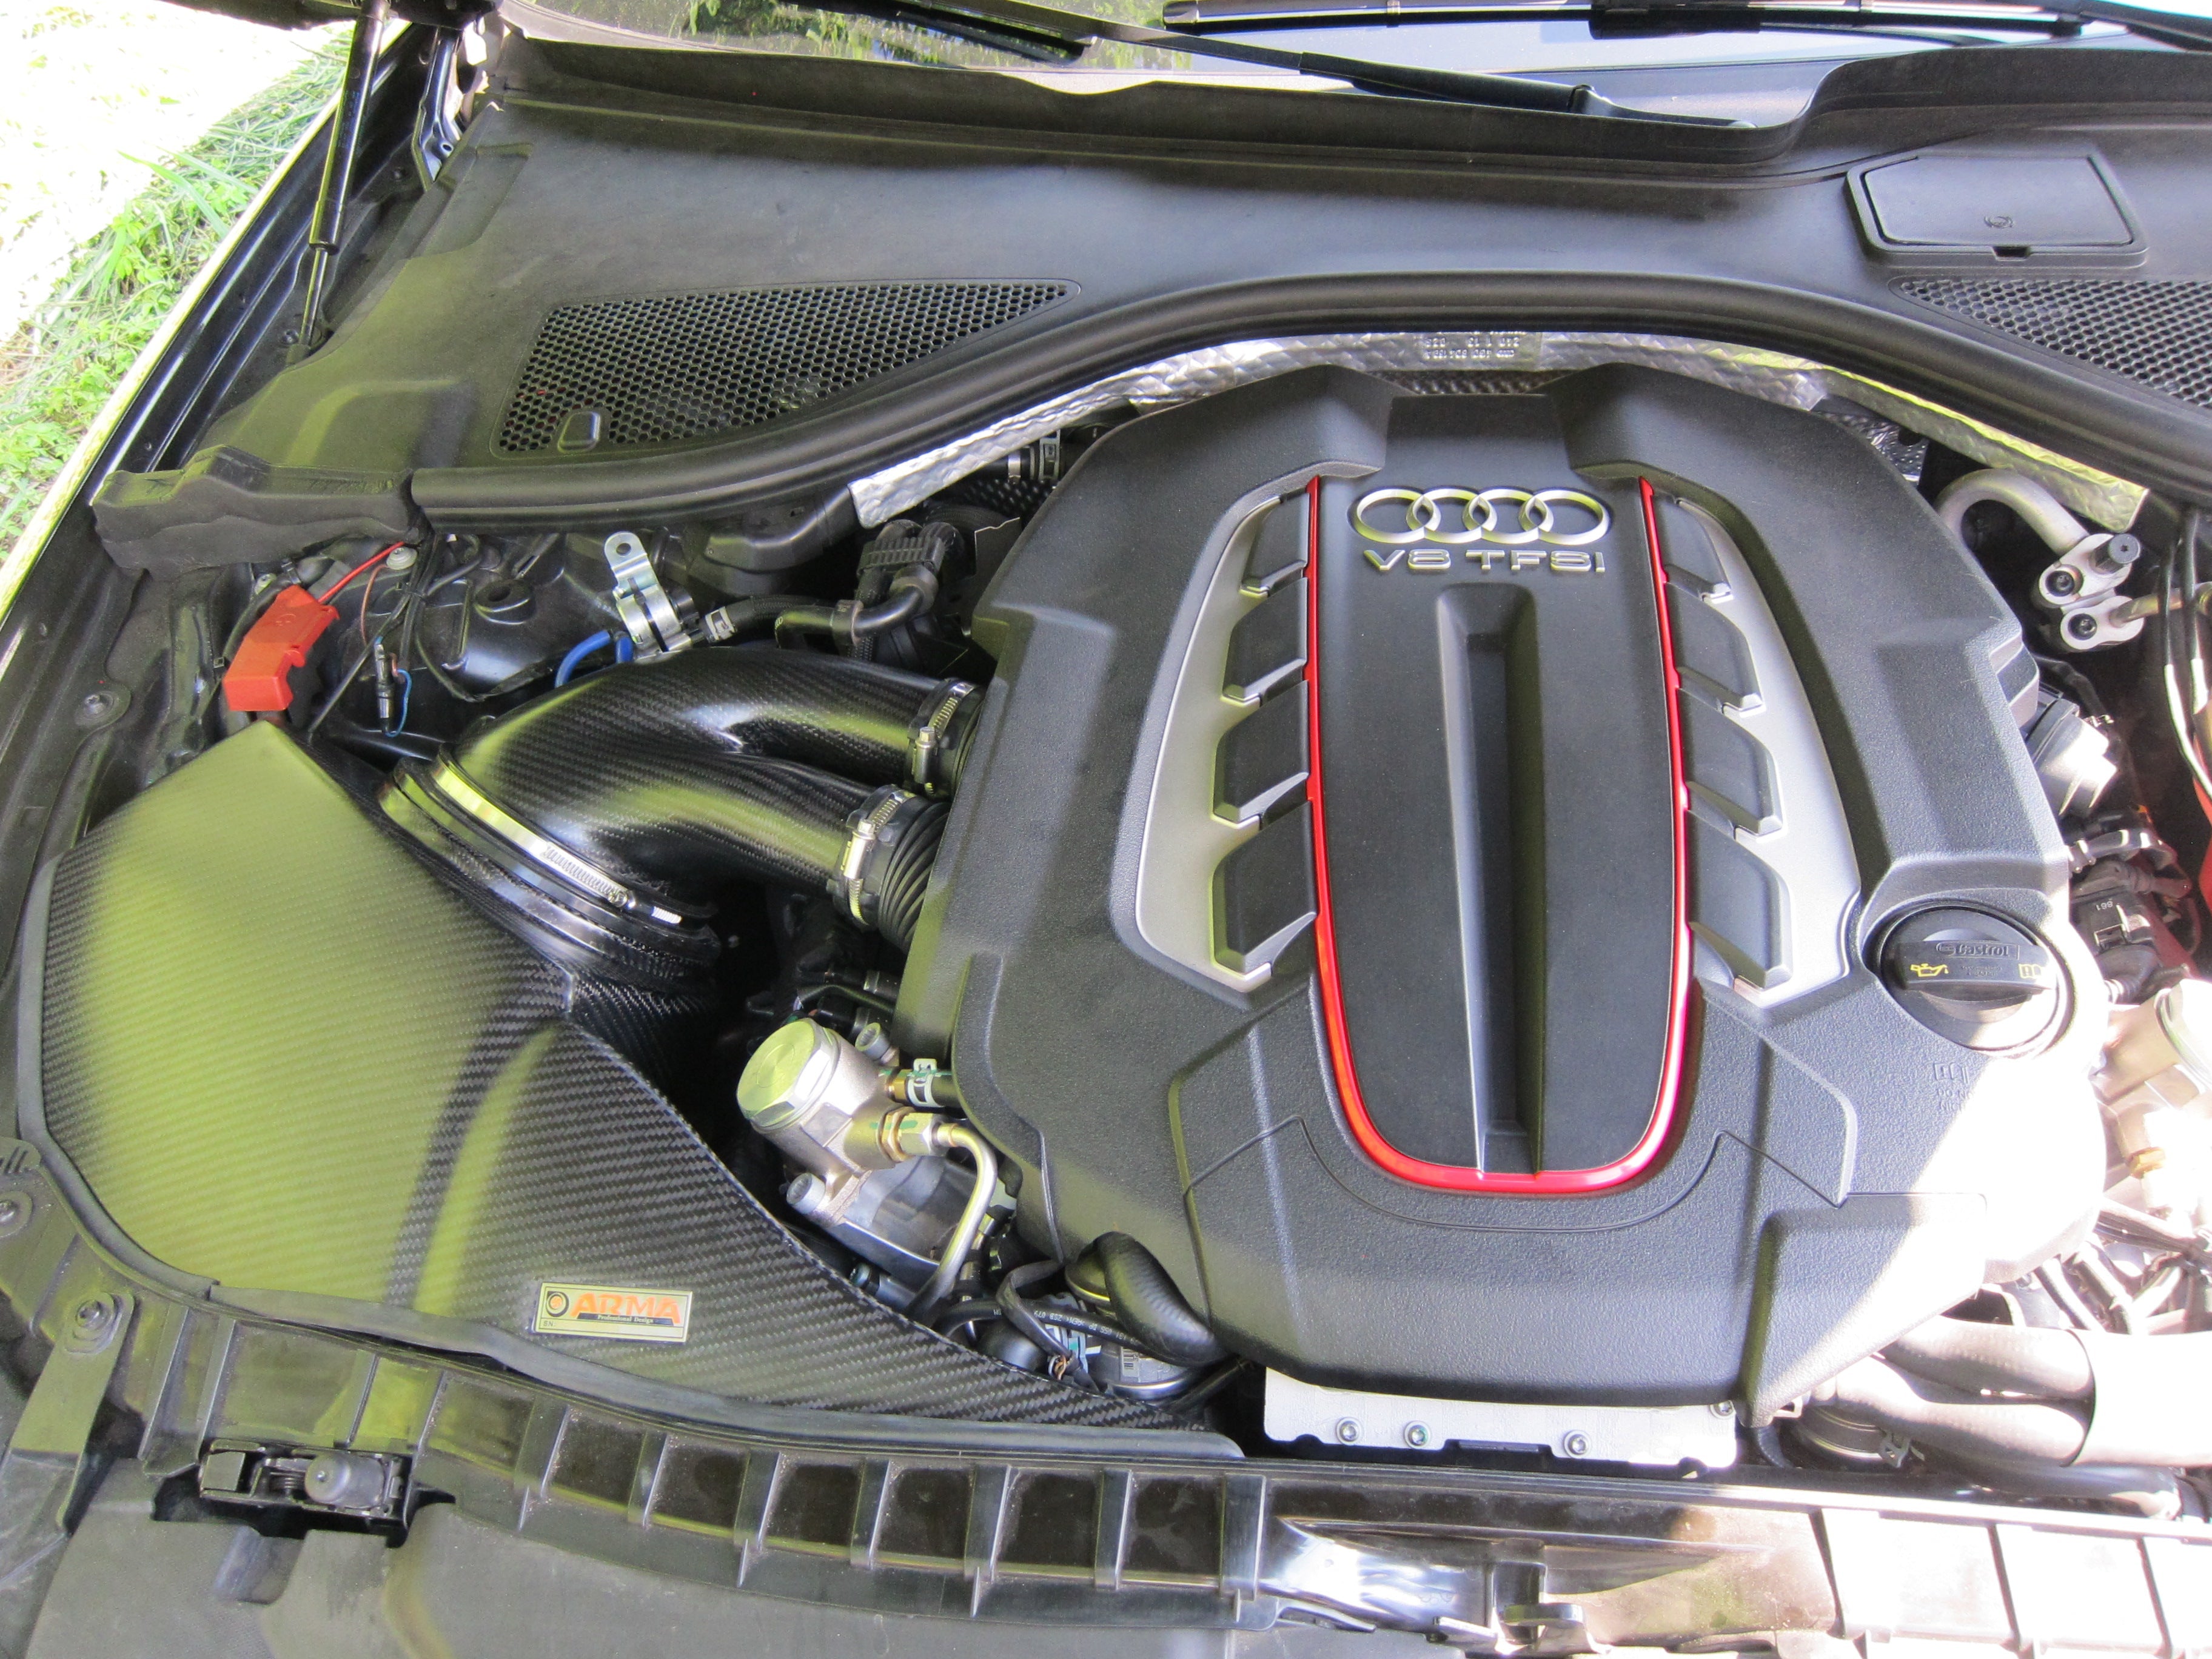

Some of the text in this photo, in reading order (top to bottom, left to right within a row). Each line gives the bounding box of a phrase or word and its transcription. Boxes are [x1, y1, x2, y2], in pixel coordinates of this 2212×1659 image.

[1364, 549, 1605, 572] V8 TFSI
[1959, 943, 2009, 956] Castrol
[570, 1292, 681, 1324] ARMA
